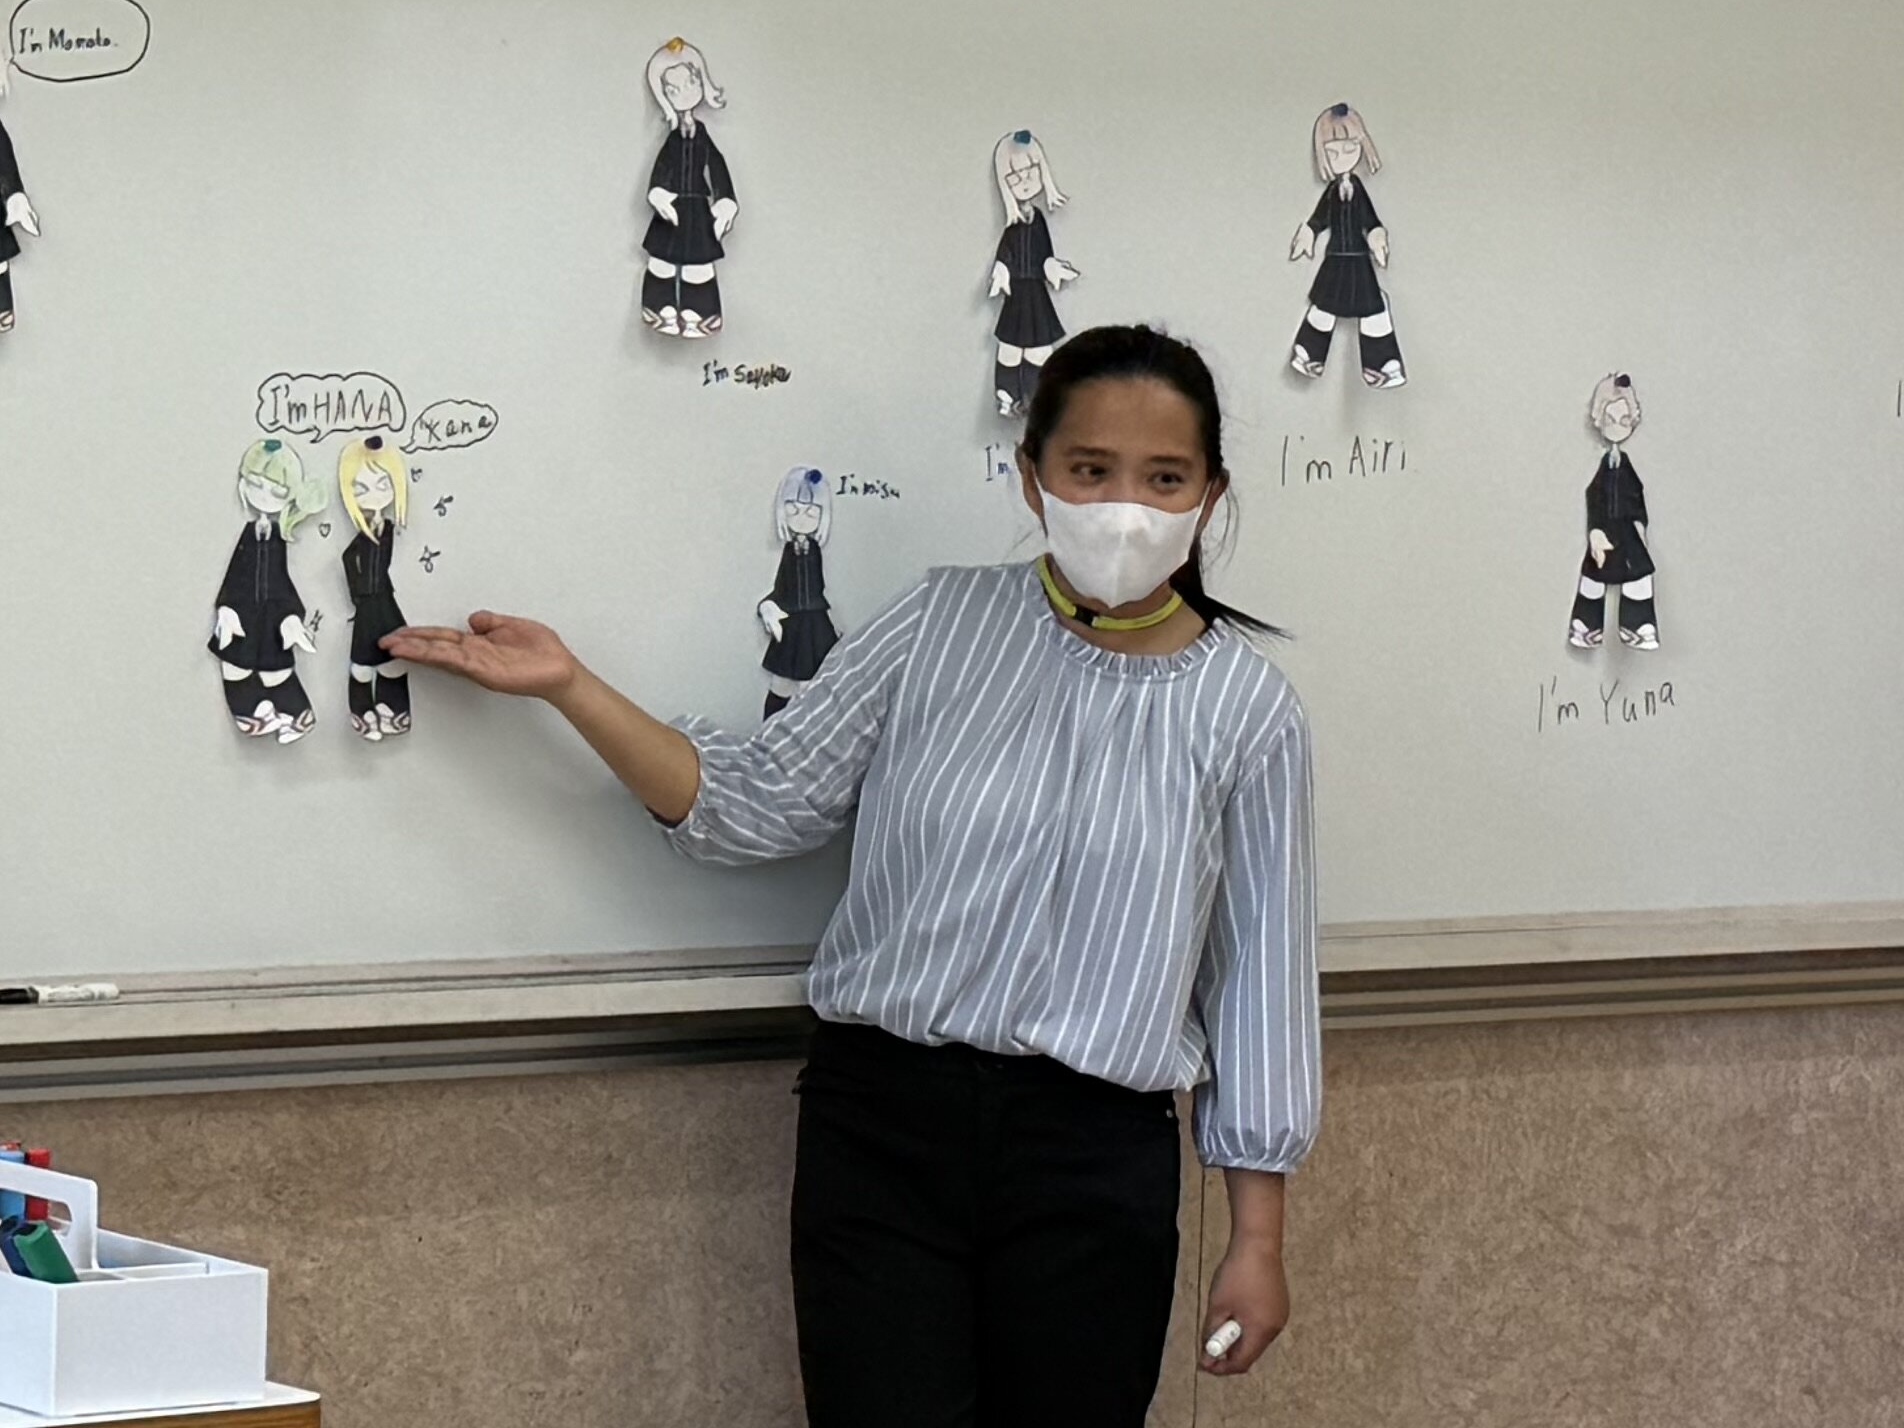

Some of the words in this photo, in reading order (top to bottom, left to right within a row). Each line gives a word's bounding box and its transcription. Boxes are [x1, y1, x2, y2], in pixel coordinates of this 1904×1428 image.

[702, 359, 729, 386] I'm
[267, 384, 307, 426] I'm
[313, 388, 392, 424] HANA
[1281, 435, 1332, 487] I'm
[1538, 675, 1579, 734] I'm
[1599, 678, 1675, 725] Yuna
